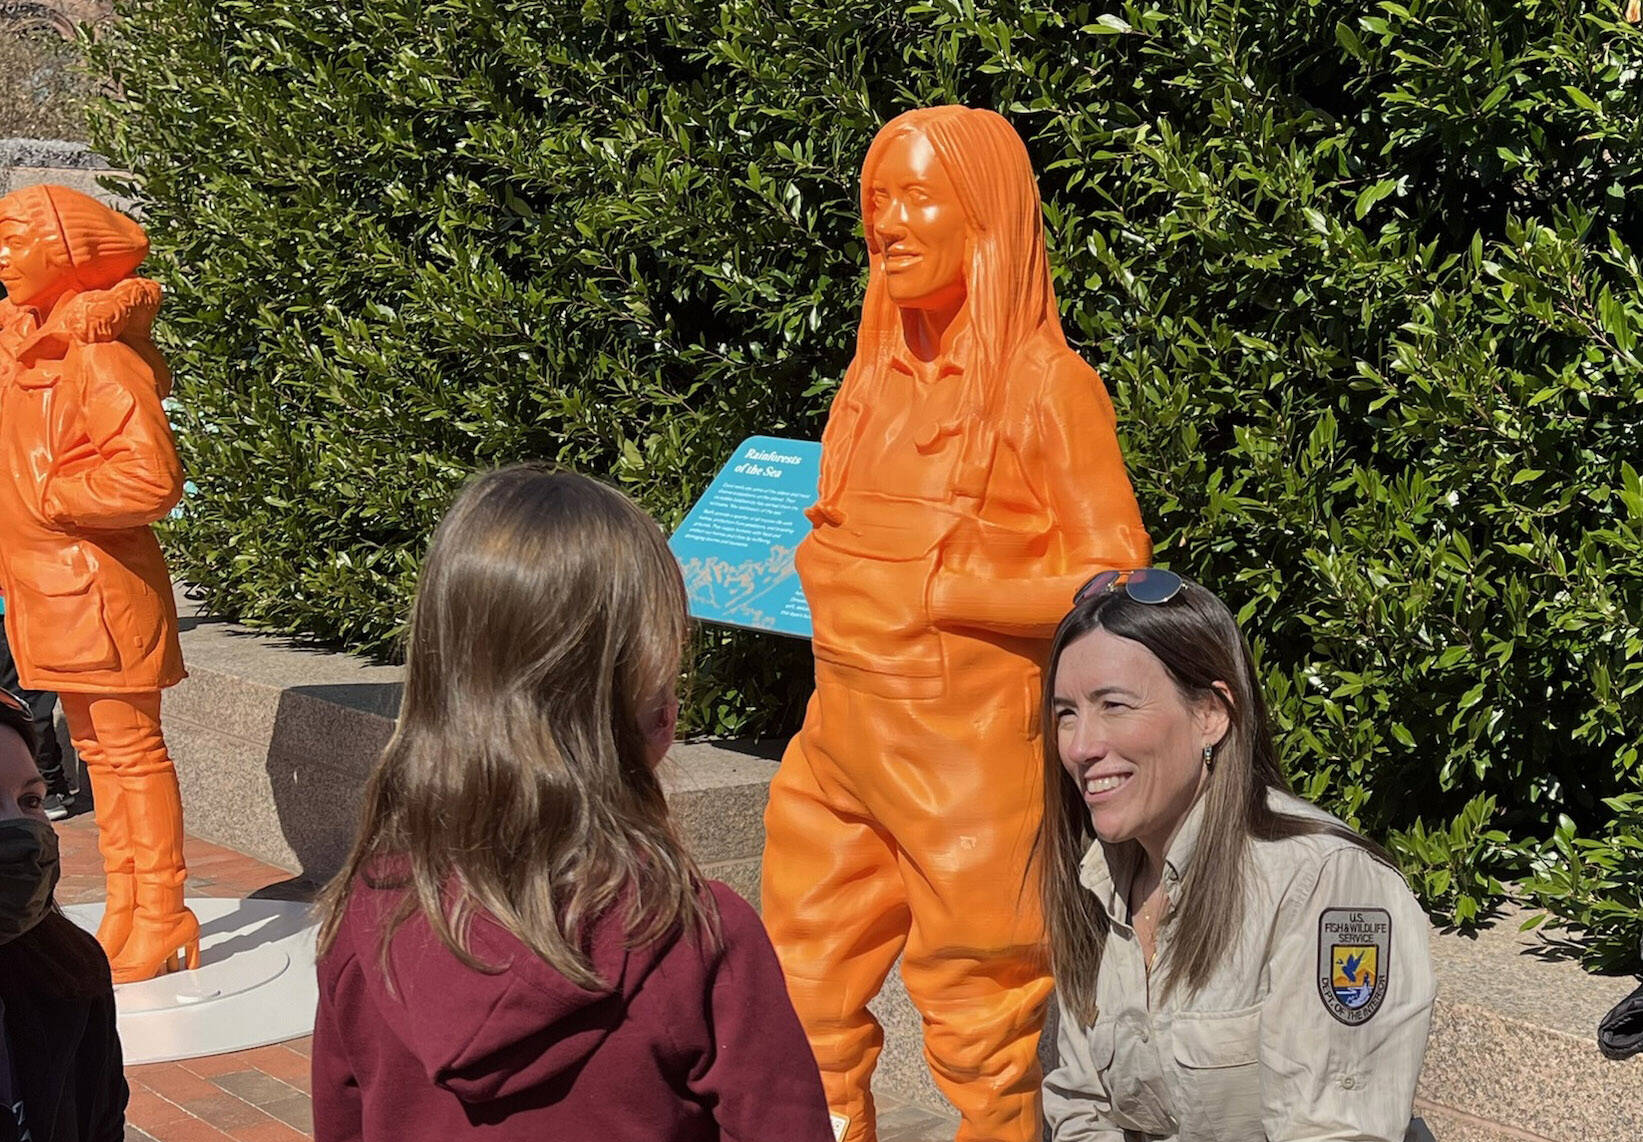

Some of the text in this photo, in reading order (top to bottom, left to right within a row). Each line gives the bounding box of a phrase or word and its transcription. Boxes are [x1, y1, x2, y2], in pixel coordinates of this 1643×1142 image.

[745, 448, 802, 465] Rainforests
[735, 463, 782, 478] of the Sea
[1338, 933, 1374, 943] SERVICE
[1322, 975, 1385, 1021] DEPT. OF THE INTERIOR
